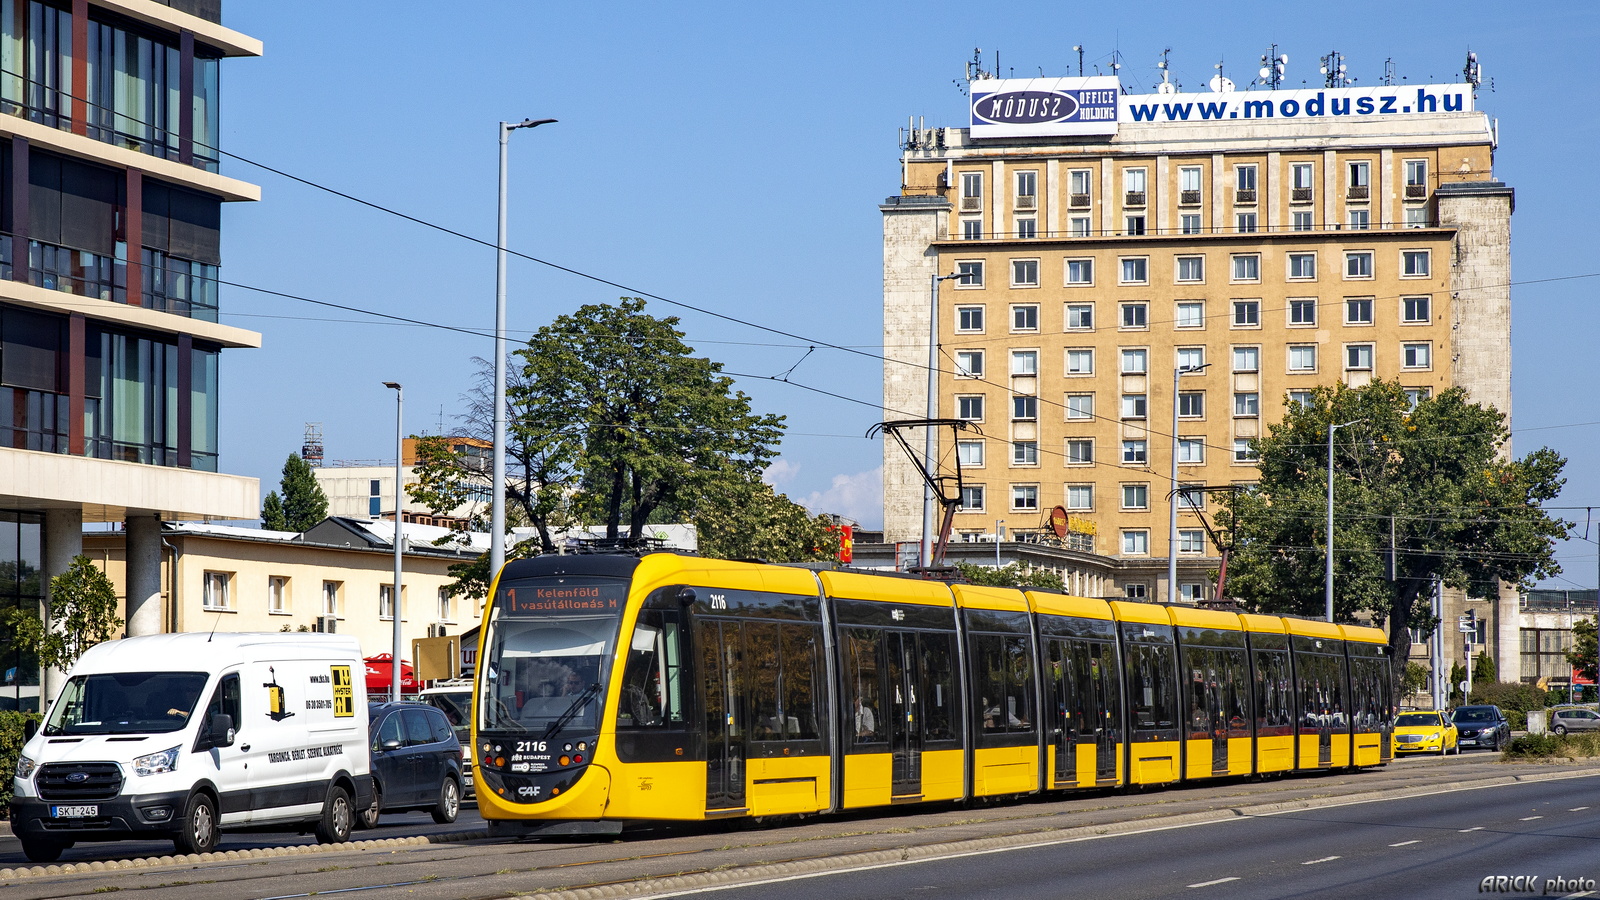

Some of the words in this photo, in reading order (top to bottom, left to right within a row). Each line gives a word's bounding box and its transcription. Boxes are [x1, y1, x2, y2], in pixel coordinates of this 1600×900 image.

[1079, 91, 1114, 104] OFFICE
[989, 95, 1061, 118] MÓDUSZ
[1129, 88, 1463, 122] www.modusz.hu
[1079, 107, 1115, 120] HOLDING
[537, 587, 599, 598] Kelenföld
[507, 588, 517, 612] 1
[520, 599, 605, 610] vasútállomás
[608, 598, 617, 608] M
[710, 594, 727, 610] 2116
[334, 687, 352, 696] HYSTER
[516, 741, 547, 752] 2116
[517, 786, 541, 797] CAF
[58, 807, 96, 816] SKT-245
